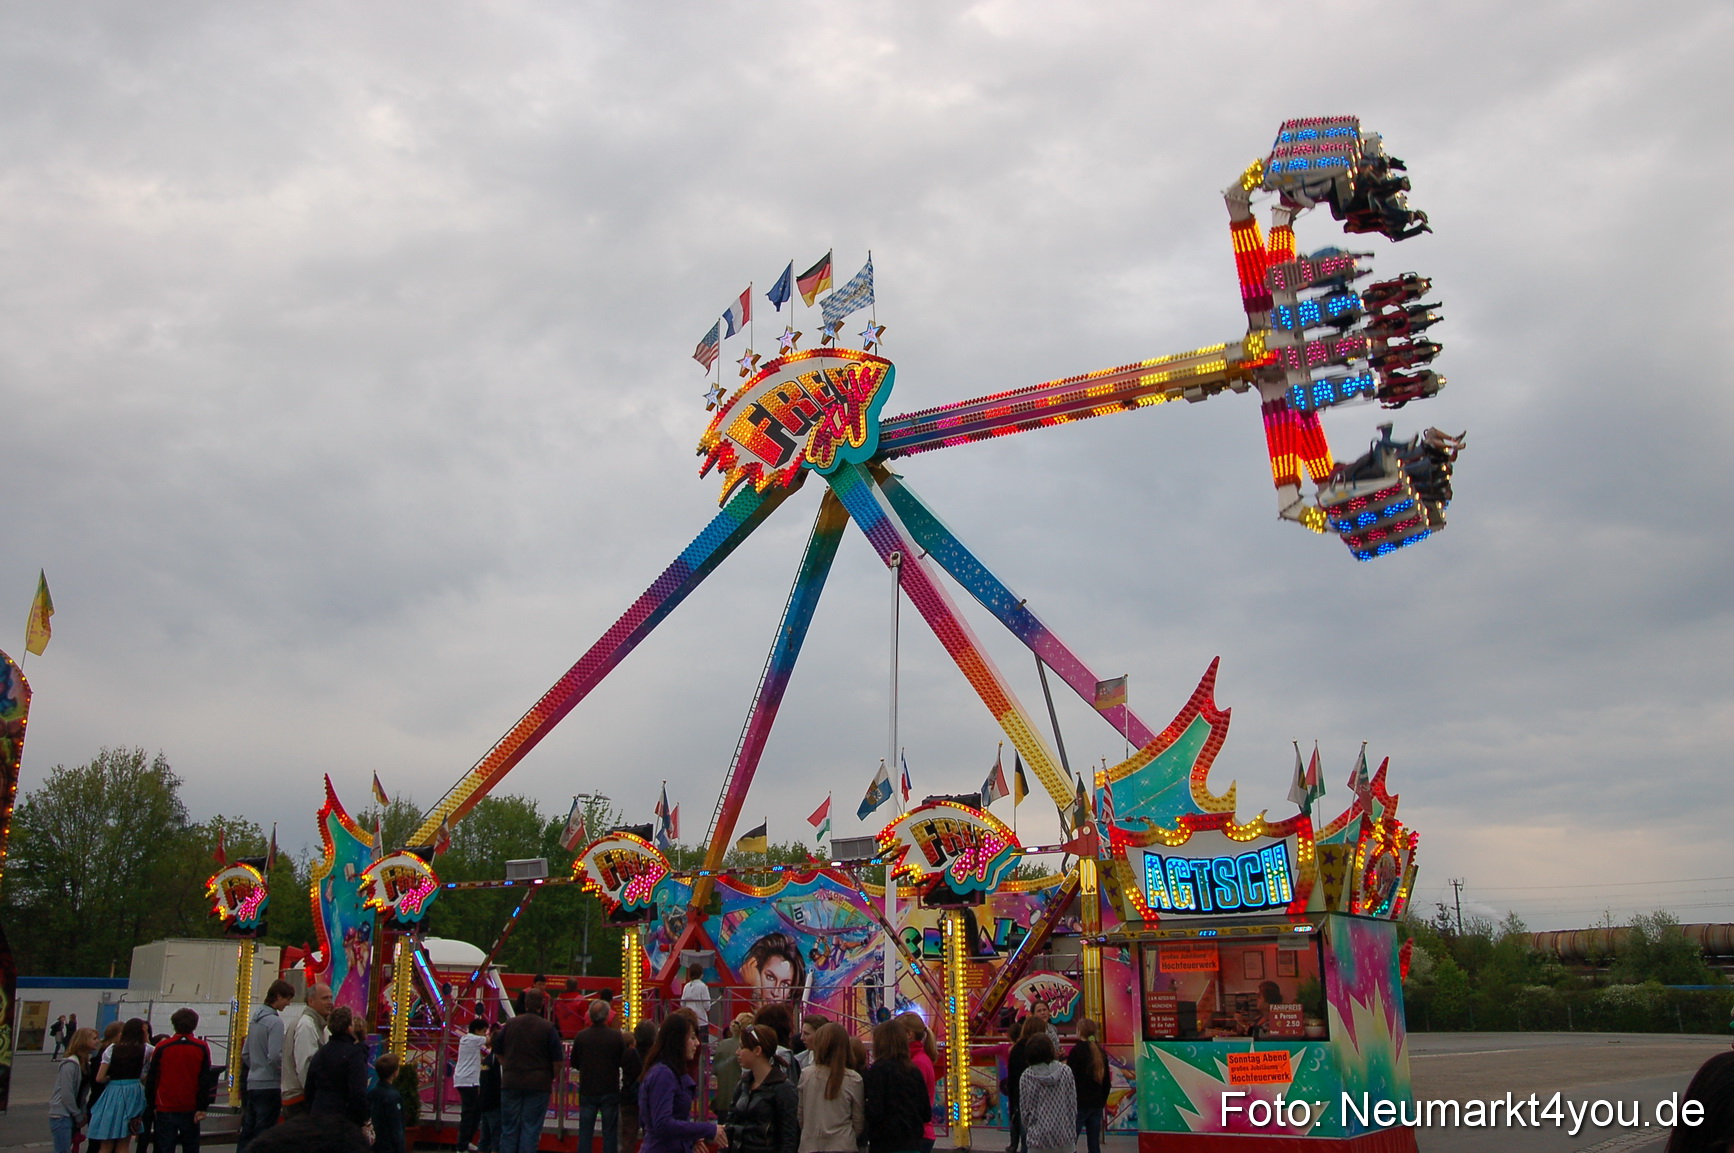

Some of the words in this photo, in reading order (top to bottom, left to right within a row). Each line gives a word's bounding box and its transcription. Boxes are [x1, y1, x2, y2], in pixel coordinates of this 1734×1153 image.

[1144, 843, 1292, 911] AGTSCH
[1161, 961, 1216, 970] Hochfeuerwerk
[1269, 1003, 1302, 1011] FAHRPREIS
[1229, 1055, 1260, 1064] Sonntag
[1263, 1053, 1287, 1062] Abend
[1231, 1072, 1289, 1082] Hochfeuerwerk
